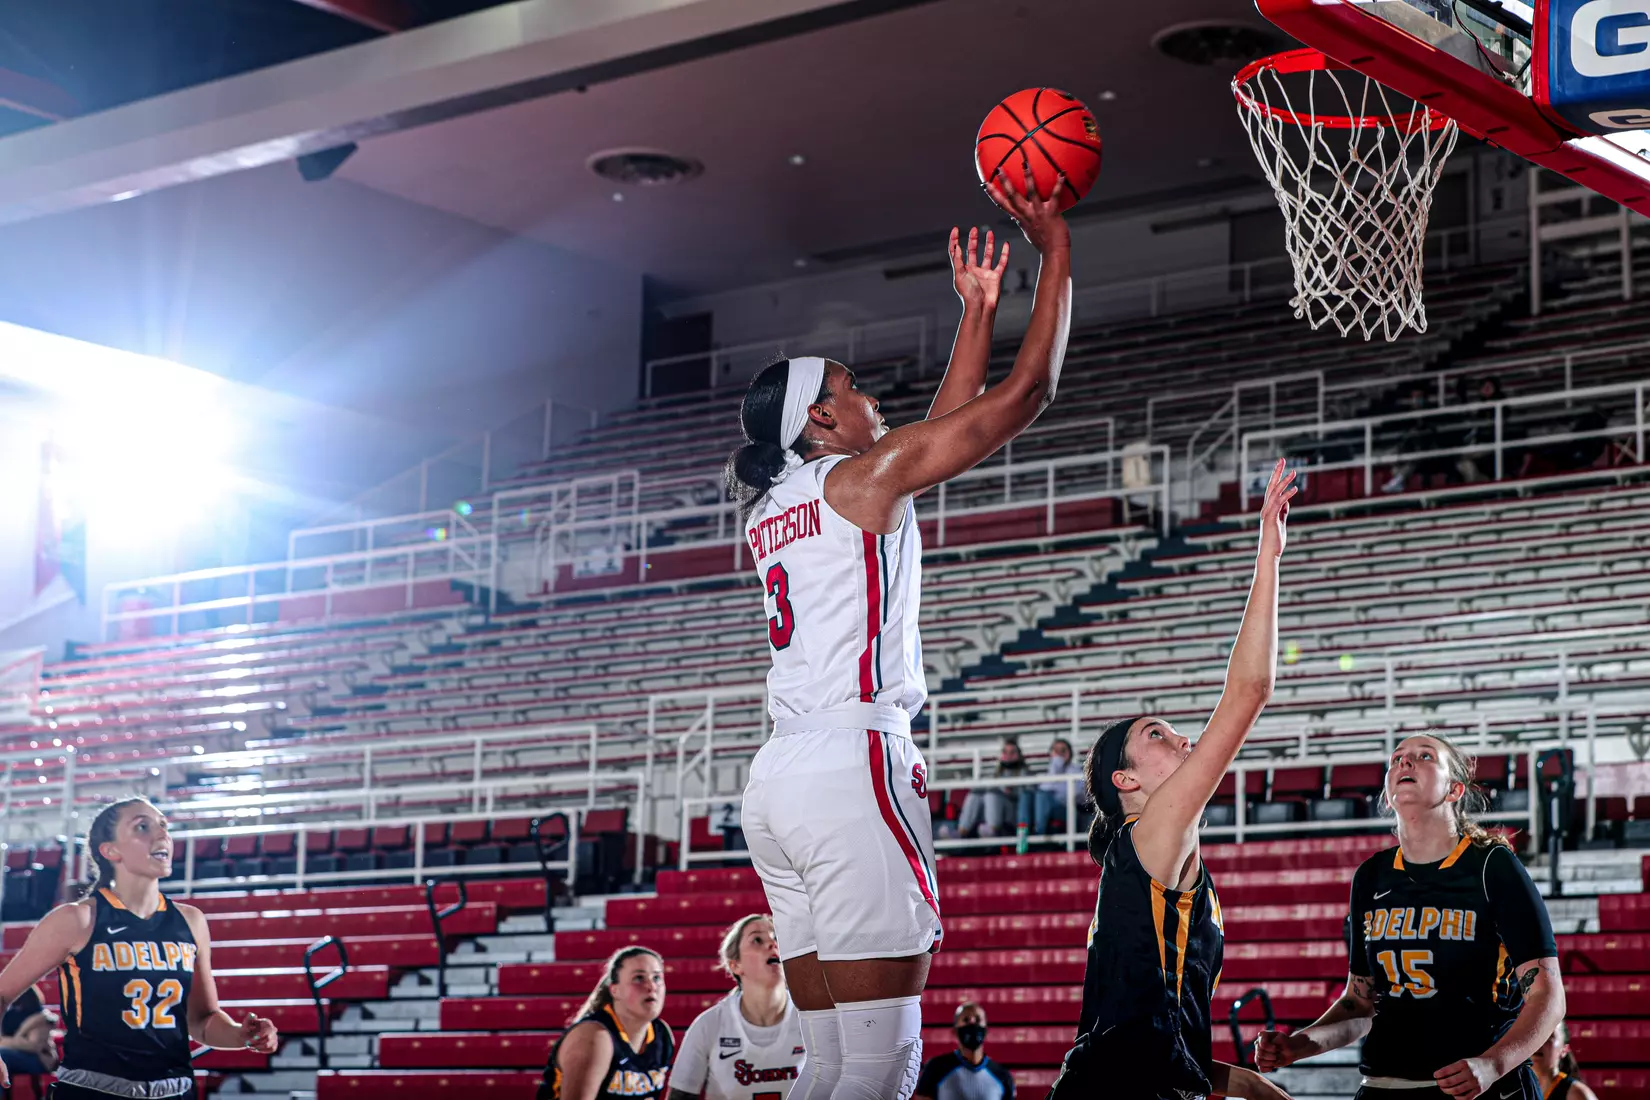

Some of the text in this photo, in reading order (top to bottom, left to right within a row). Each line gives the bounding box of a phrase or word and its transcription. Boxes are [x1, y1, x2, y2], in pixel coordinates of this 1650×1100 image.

[749, 499, 822, 564] PATTERSON
[765, 561, 796, 651] 3
[122, 978, 184, 1029] 32
[1377, 950, 1439, 999] 15
